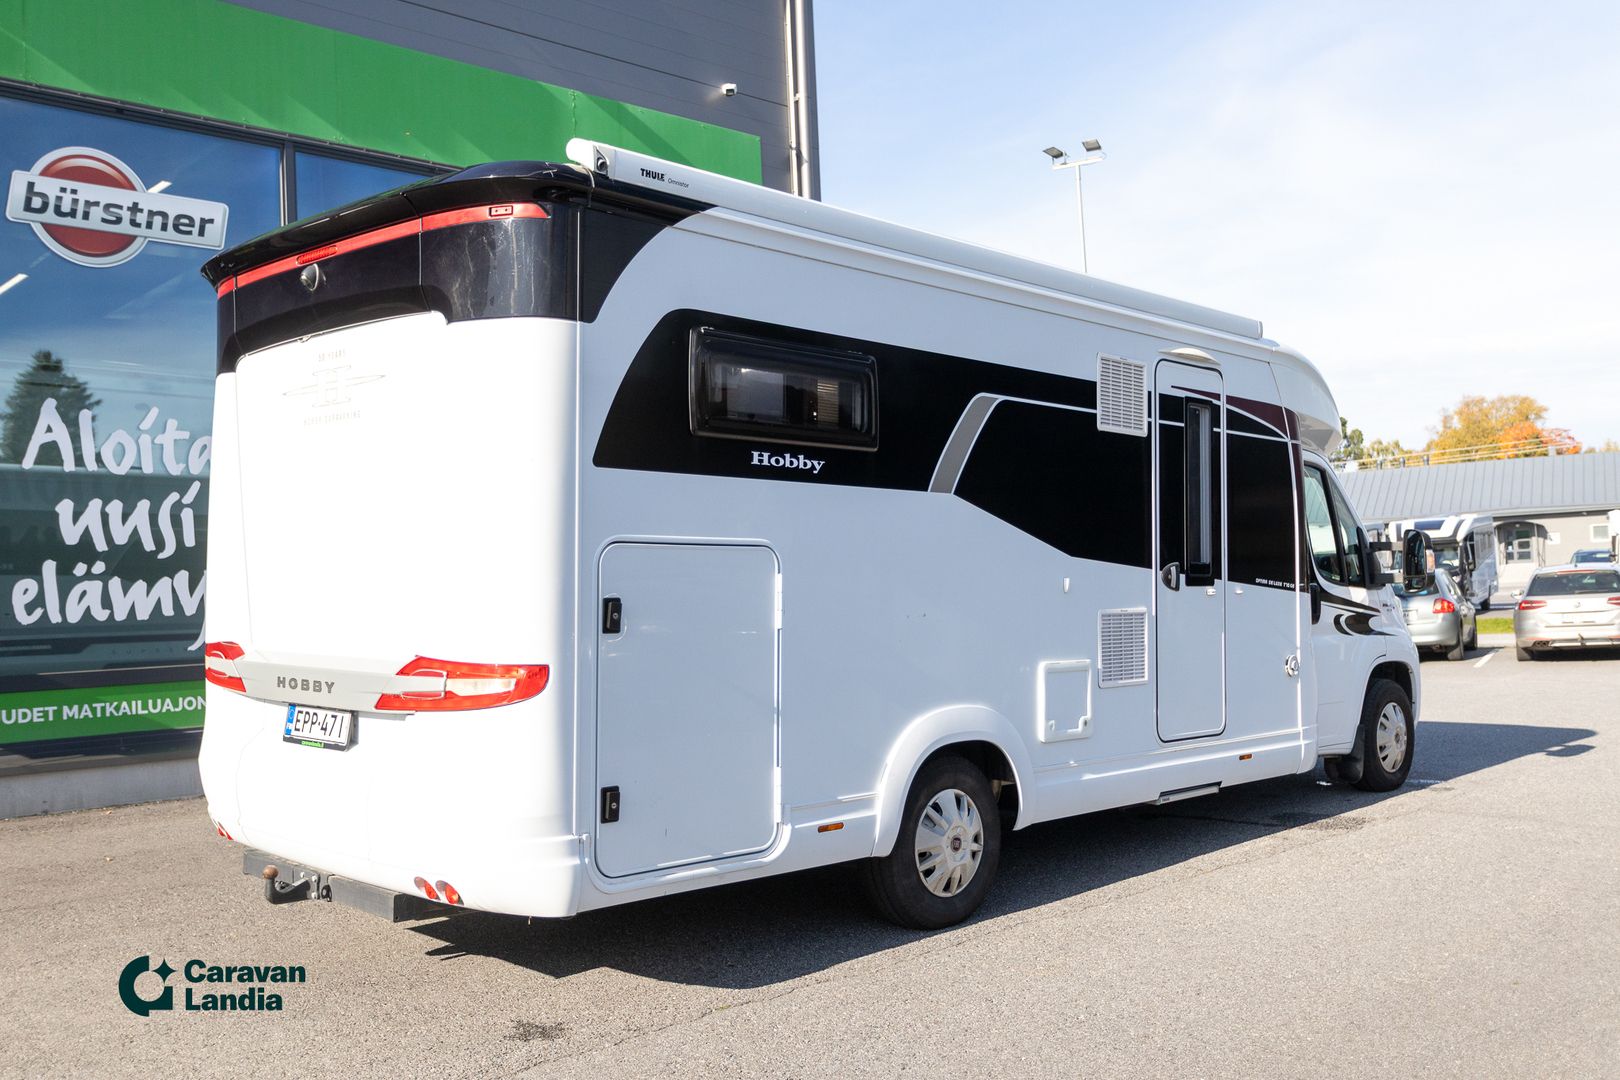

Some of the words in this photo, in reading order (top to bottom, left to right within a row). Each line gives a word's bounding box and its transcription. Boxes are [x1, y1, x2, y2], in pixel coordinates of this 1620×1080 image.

[640, 168, 665, 181] THULE
[668, 178, 689, 188] Omnistor
[22, 181, 215, 238] bürstner
[750, 451, 825, 474] Hobby
[55, 480, 200, 559] uusi
[277, 676, 335, 694] HOBBY
[294, 709, 344, 738] EPP-471
